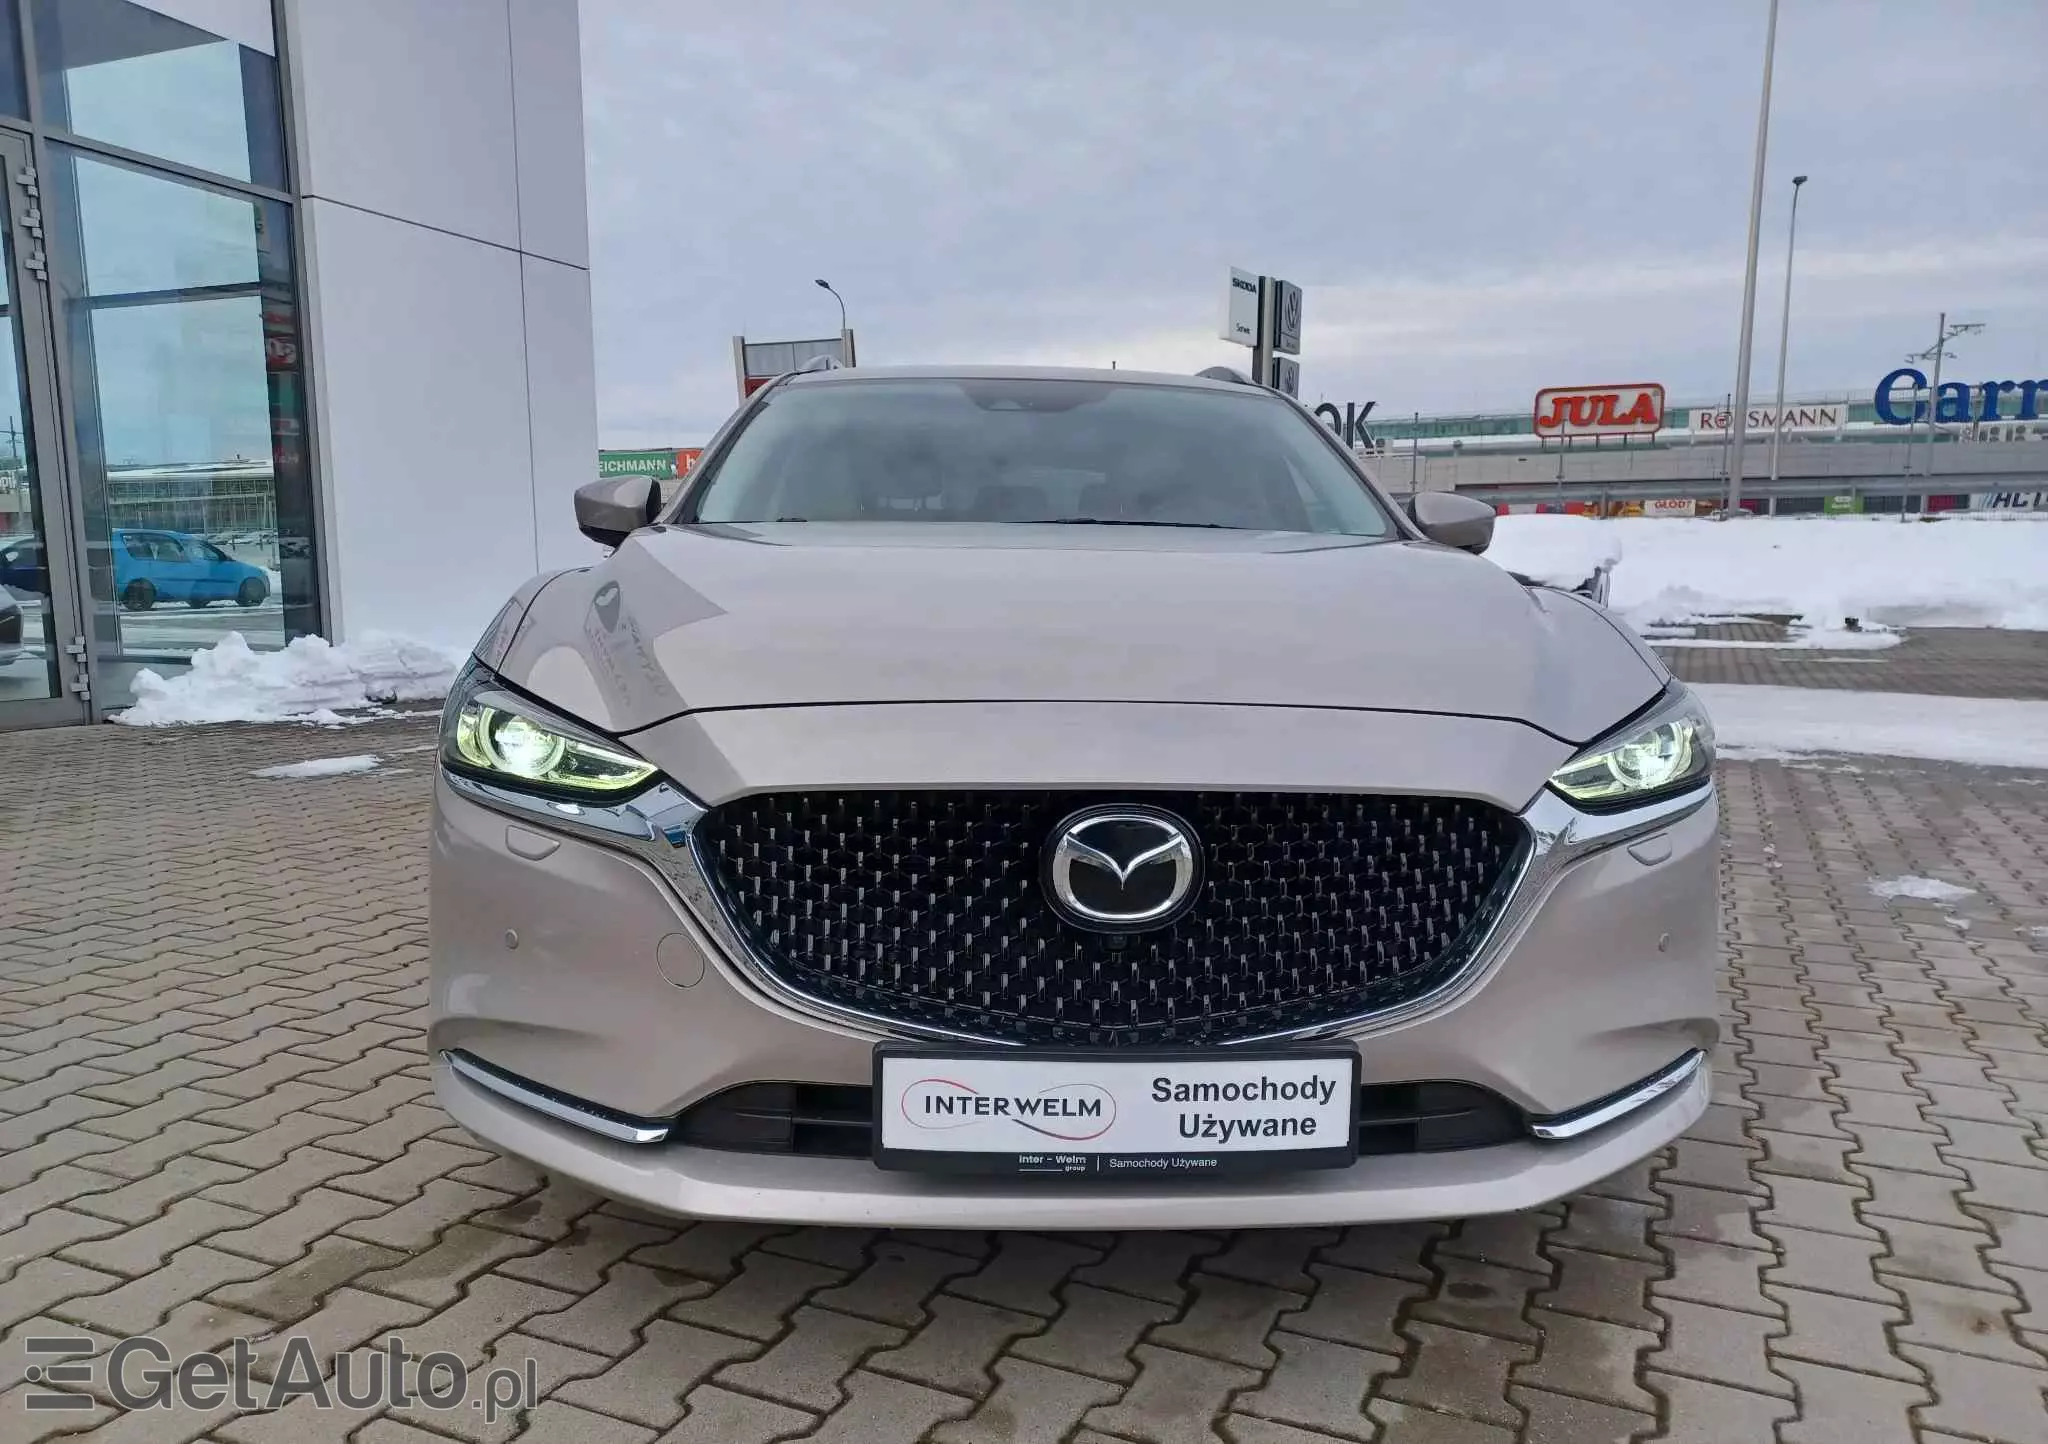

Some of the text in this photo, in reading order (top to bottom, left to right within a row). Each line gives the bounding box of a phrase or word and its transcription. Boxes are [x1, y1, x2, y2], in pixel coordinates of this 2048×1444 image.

[1539, 392, 1658, 428] JULA
[1700, 407, 1837, 429] ROSMANN
[1151, 1074, 1337, 1106] Samochody
[1179, 1112, 1317, 1144] Używane
[1018, 1154, 1044, 1165] Inter
[1055, 1154, 1087, 1165] Welm
[1064, 1164, 1087, 1173] group
[1108, 1156, 1218, 1170] Samochody Używane
